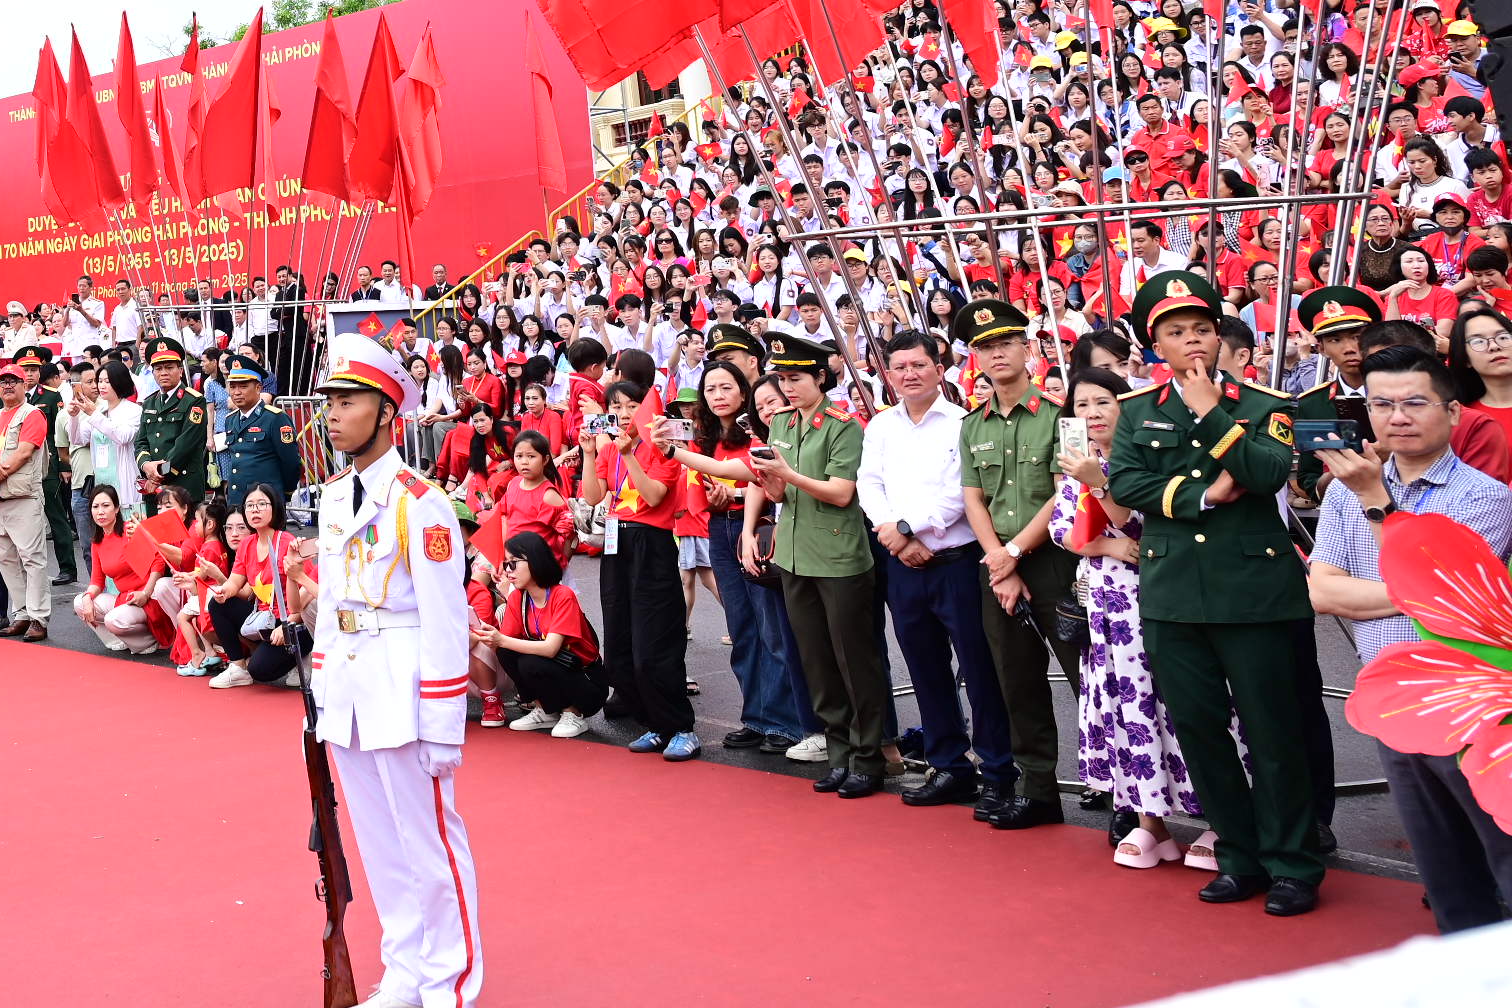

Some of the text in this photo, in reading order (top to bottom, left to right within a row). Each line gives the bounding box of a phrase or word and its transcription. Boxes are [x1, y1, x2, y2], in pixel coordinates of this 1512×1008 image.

[95, 89, 115, 103] UBN
[285, 39, 321, 62] PHÒN
[4, 243, 18, 259] 70
[19, 237, 45, 257] NĂM
[46, 232, 78, 254] NGÀY
[154, 218, 177, 241] HẢI
[163, 238, 245, 269] 13/5/2025)
[97, 284, 118, 299] Phòn
[221, 272, 248, 289] 2025
